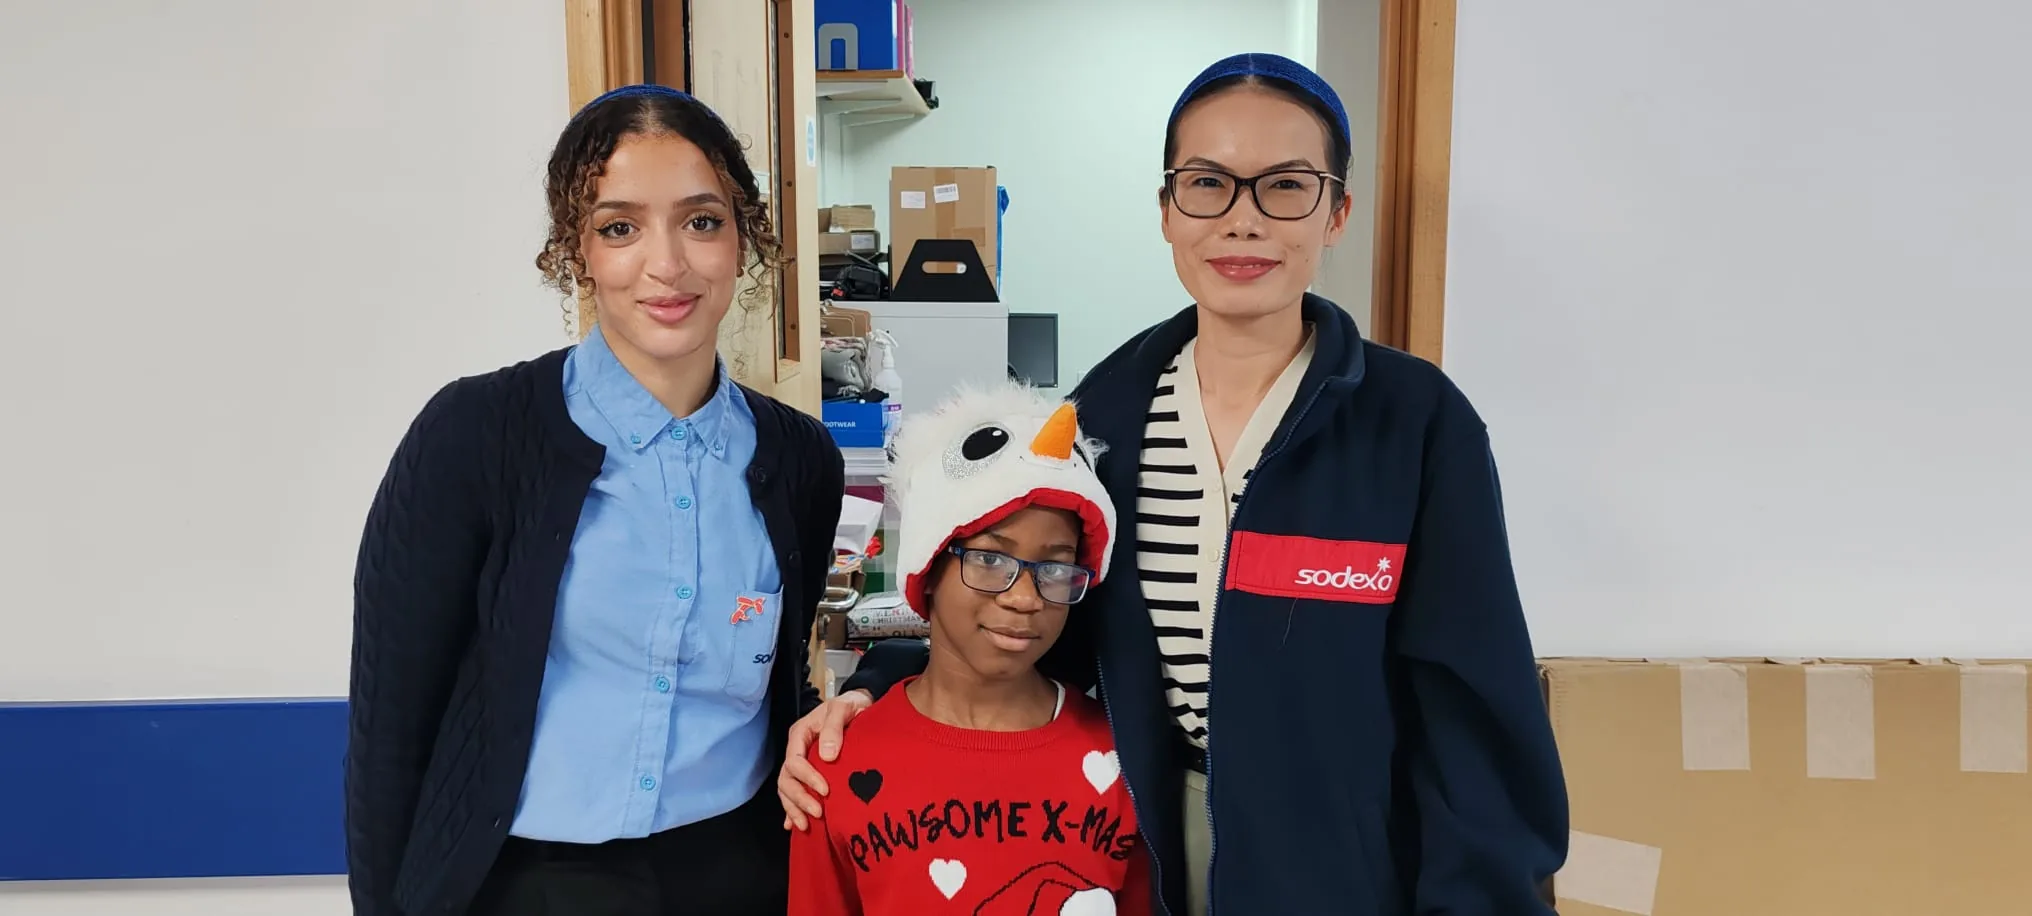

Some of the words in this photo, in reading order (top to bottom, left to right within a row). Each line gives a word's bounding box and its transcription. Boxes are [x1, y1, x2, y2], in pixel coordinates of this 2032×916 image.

[1294, 562, 1393, 592] sodexo
[850, 799, 1032, 873] PAWSOME
[1041, 800, 1137, 861] X-MAS
